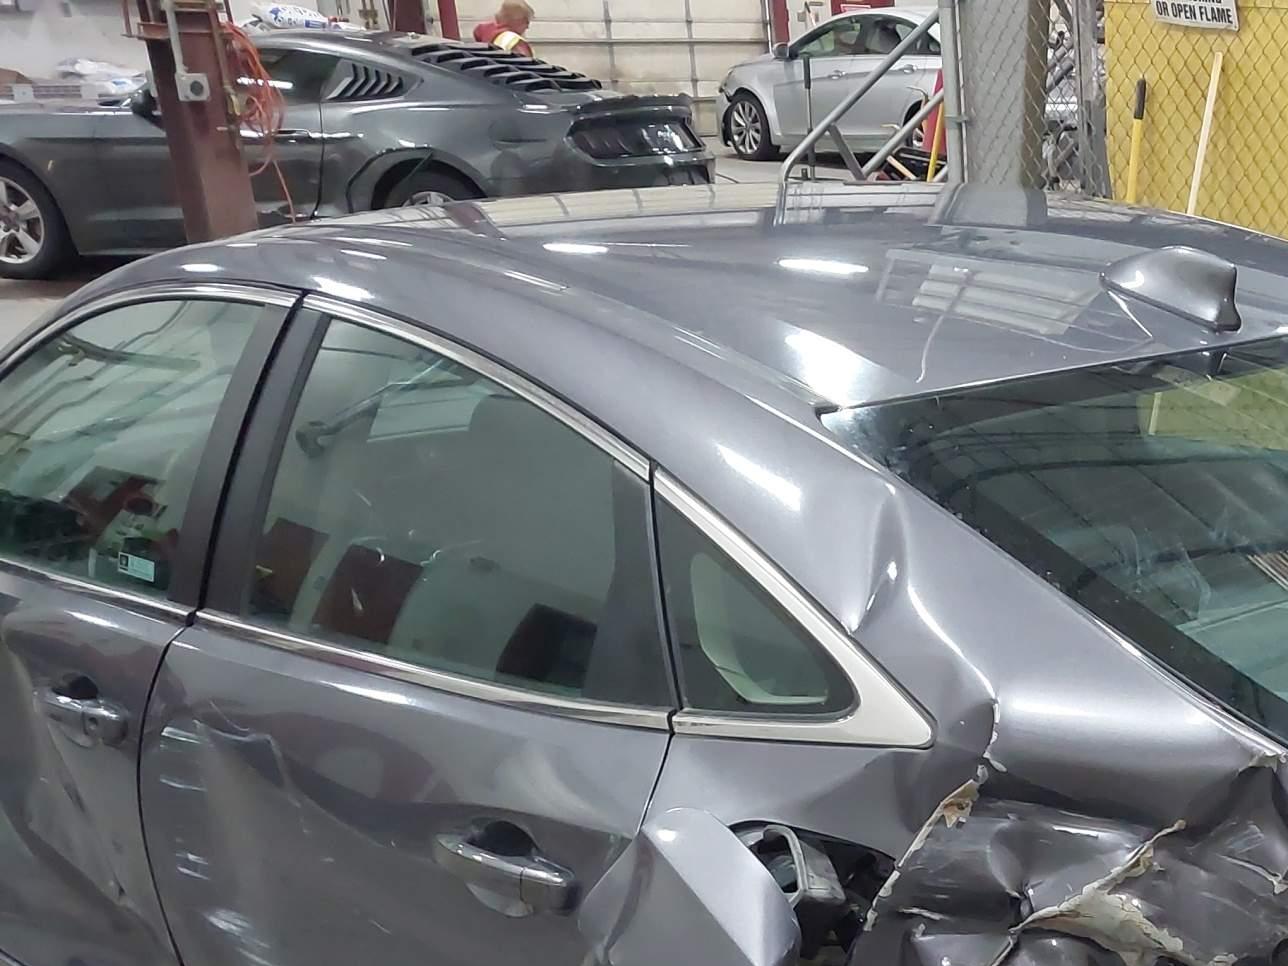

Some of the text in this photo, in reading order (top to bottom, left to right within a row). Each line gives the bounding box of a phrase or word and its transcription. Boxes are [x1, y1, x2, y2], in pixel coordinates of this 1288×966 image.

[1156, 0, 1234, 24] OR OPEN FLAME
